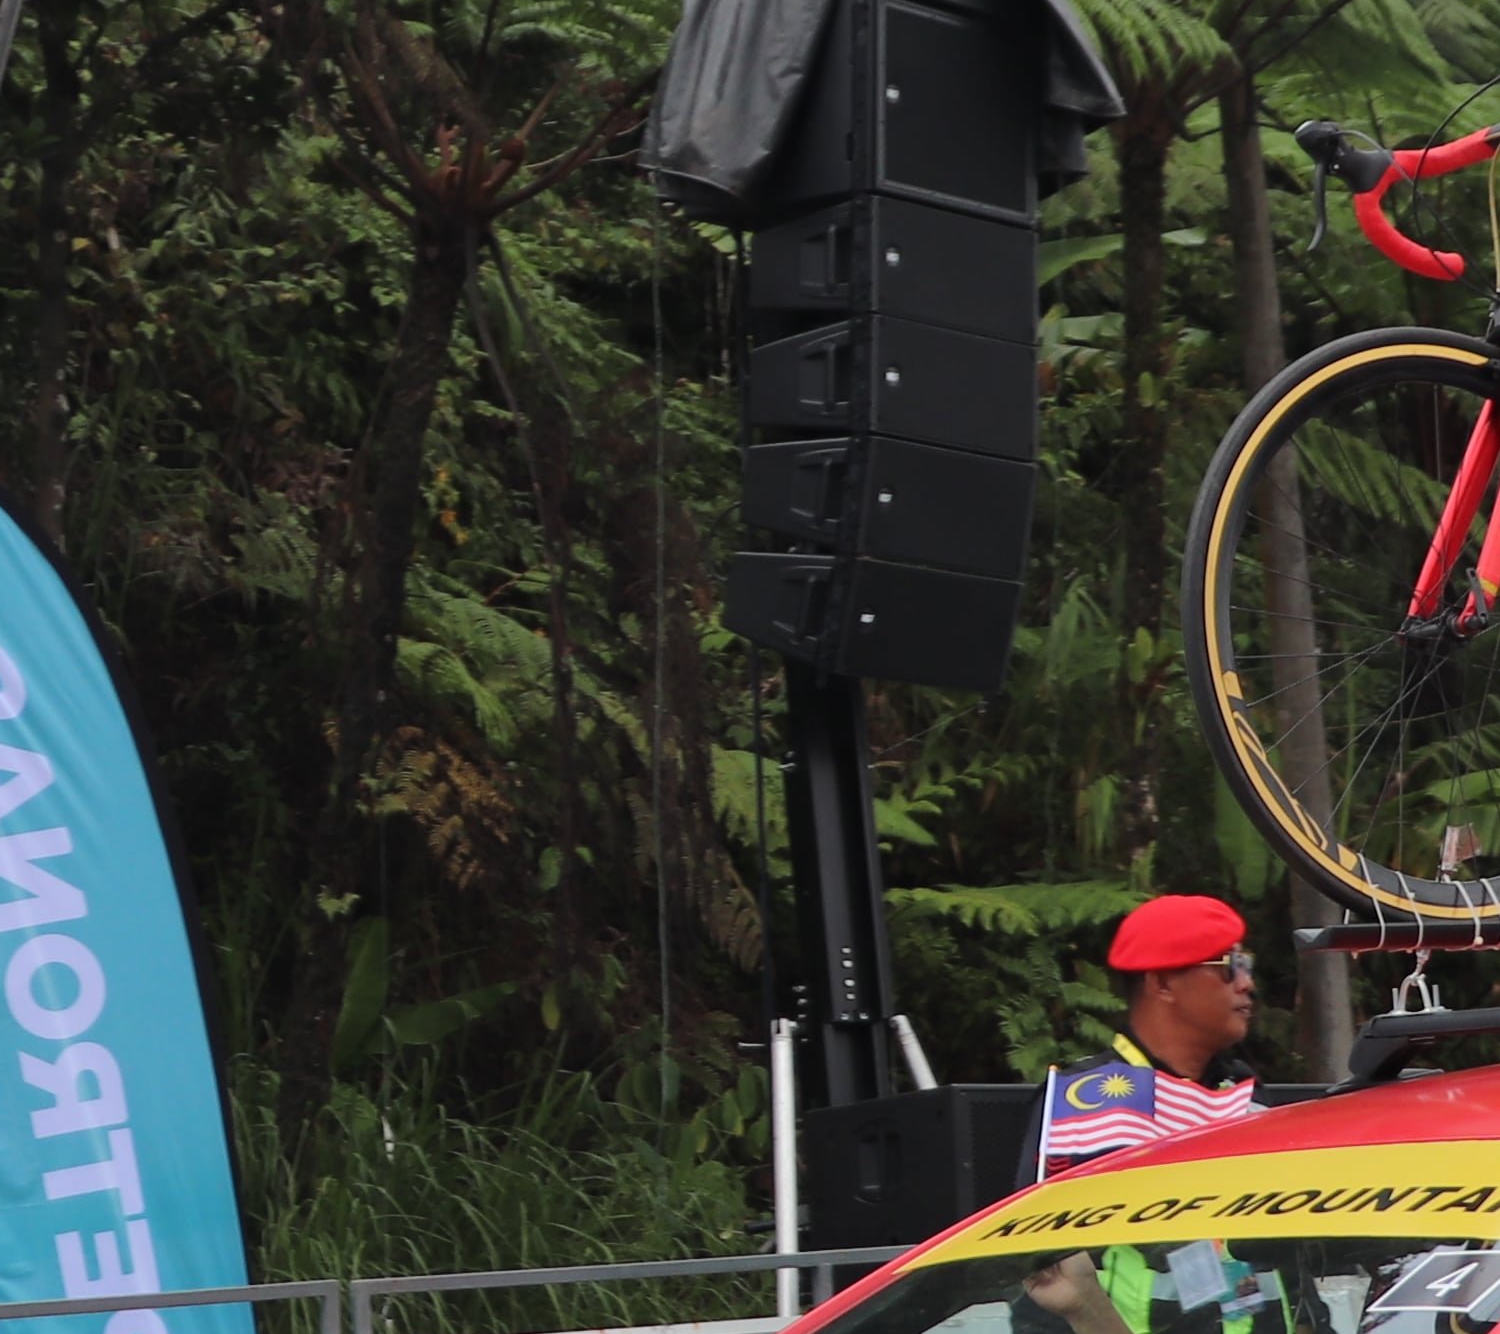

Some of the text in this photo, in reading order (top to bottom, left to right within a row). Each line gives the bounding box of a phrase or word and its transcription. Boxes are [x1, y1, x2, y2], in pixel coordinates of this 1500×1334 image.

[981, 1200, 1136, 1240] KING
[1123, 1192, 1211, 1228] OF
[1427, 1258, 1481, 1301] 4
